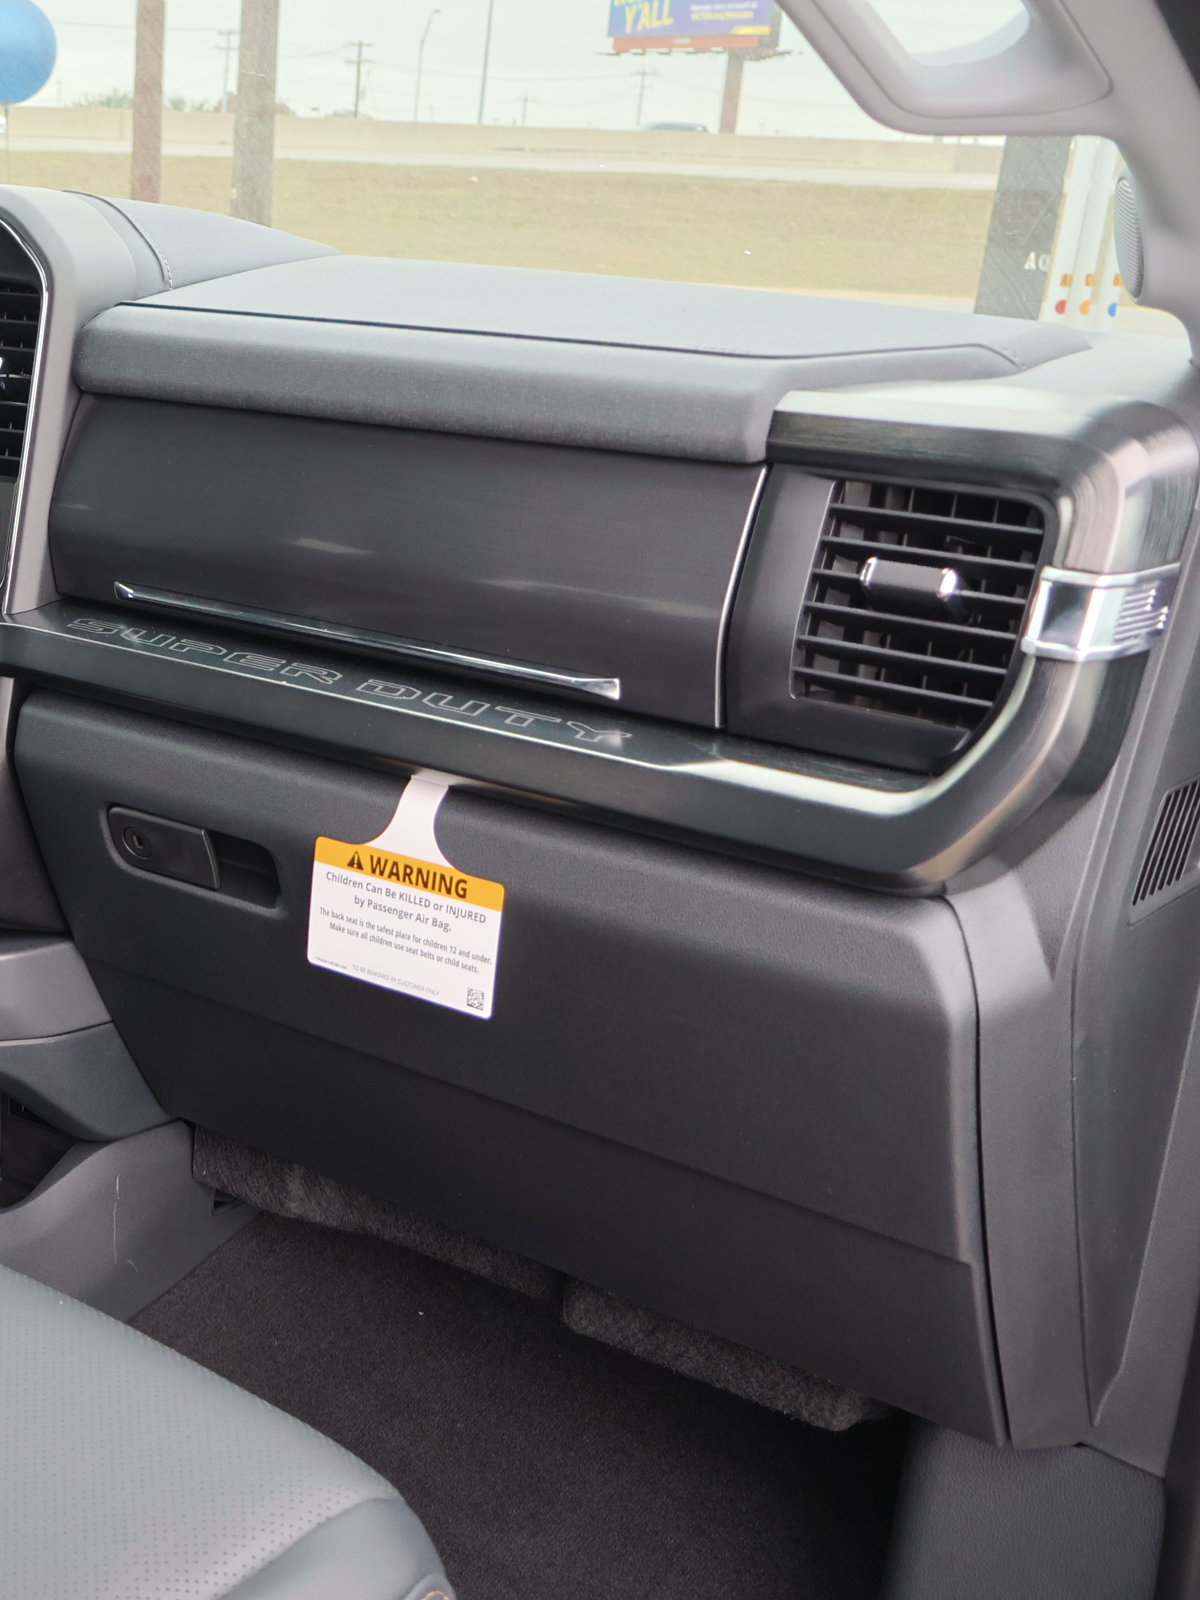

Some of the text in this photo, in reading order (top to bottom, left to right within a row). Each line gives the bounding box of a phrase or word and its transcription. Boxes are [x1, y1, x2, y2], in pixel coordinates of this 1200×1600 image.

[67, 616, 632, 743] SUPER DUTY
[326, 872, 486, 924] Children Can Be KILLED or INJURED
[370, 854, 468, 899] WARNING
[320, 907, 492, 964] The back seat is the safest place for children 12 and under.
[354, 895, 452, 933] by Passenger Air Bag.
[330, 922, 345, 934] Make
[347, 928, 359, 937] sure
[369, 934, 392, 948] children
[394, 942, 404, 950] use
[406, 945, 418, 955] seat
[420, 948, 434, 960] belts
[445, 956, 460, 968] child
[461, 961, 479, 973] seats.
